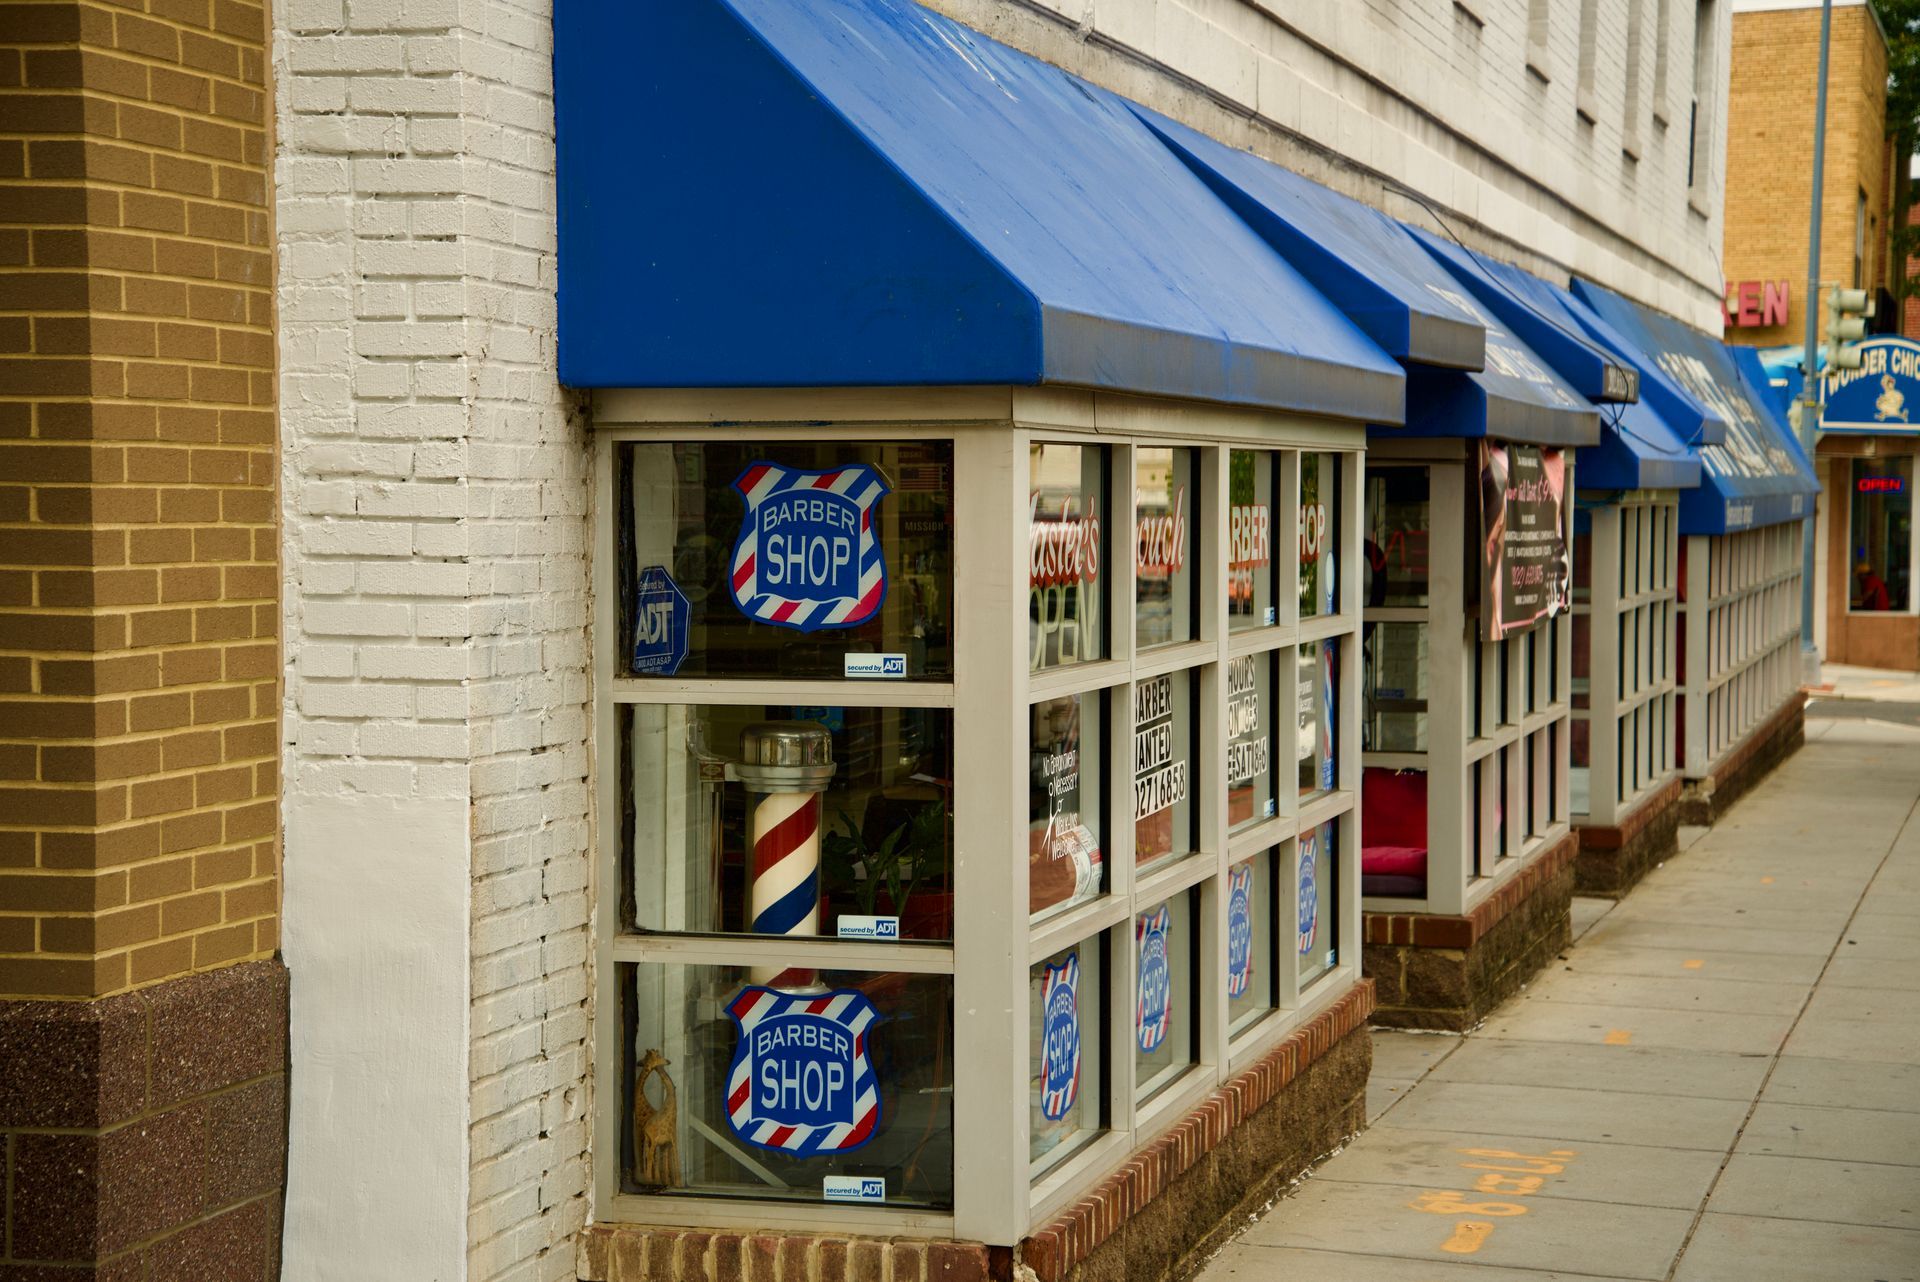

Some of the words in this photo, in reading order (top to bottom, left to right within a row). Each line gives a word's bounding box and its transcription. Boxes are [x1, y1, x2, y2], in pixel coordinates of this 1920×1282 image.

[1858, 478, 1901, 492] OPEN
[763, 499, 856, 536] BARBER
[1030, 492, 1099, 582] aster's
[1136, 486, 1185, 570] ouch
[1229, 505, 1269, 564] RBER
[766, 534, 850, 586] SHOP
[636, 602, 674, 646] ADT
[847, 664, 873, 673] secured
[874, 664, 882, 674] by
[884, 658, 904, 674] ADT
[1135, 677, 1171, 723] ARBER
[1135, 724, 1171, 773] ANTED
[840, 926, 866, 935] secured
[867, 927, 875, 936] by
[876, 920, 896, 936] ADT
[1230, 922, 1247, 966] SHOP
[1049, 992, 1073, 1032] BARBER
[1145, 966, 1164, 1017] SHOP
[757, 1024, 849, 1061] BARBER
[1050, 1023, 1073, 1081] SHOP
[761, 1058, 845, 1112] SHOP
[826, 1187, 852, 1196] secured
[853, 1187, 861, 1197] by
[863, 1181, 882, 1198] ADT
